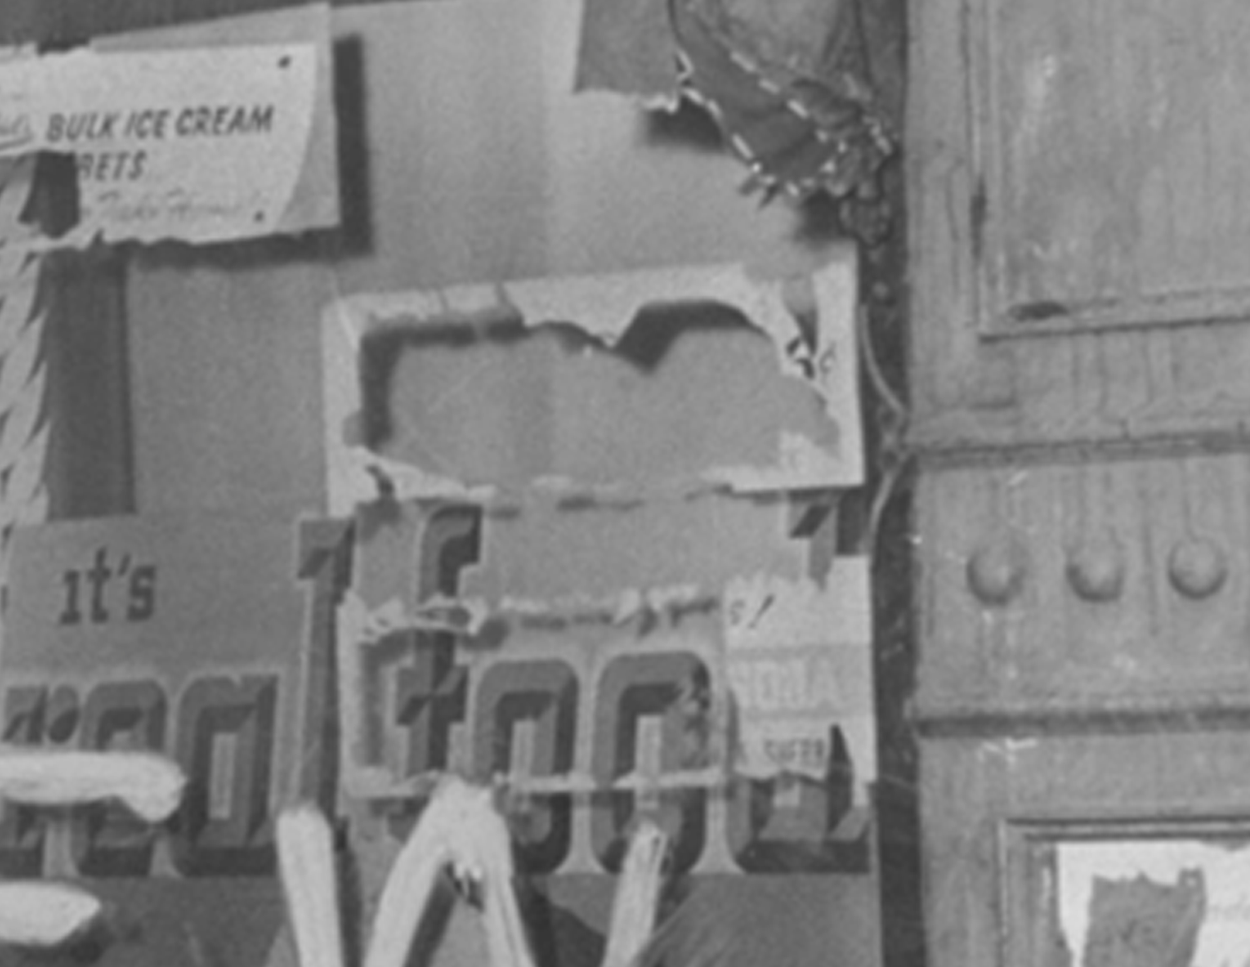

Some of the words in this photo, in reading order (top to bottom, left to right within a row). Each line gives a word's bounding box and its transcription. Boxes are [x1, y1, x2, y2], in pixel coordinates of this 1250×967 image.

[46, 111, 116, 142] BULK
[124, 109, 169, 140] ICE
[175, 105, 274, 137] CREAM
[59, 545, 156, 626] it's
